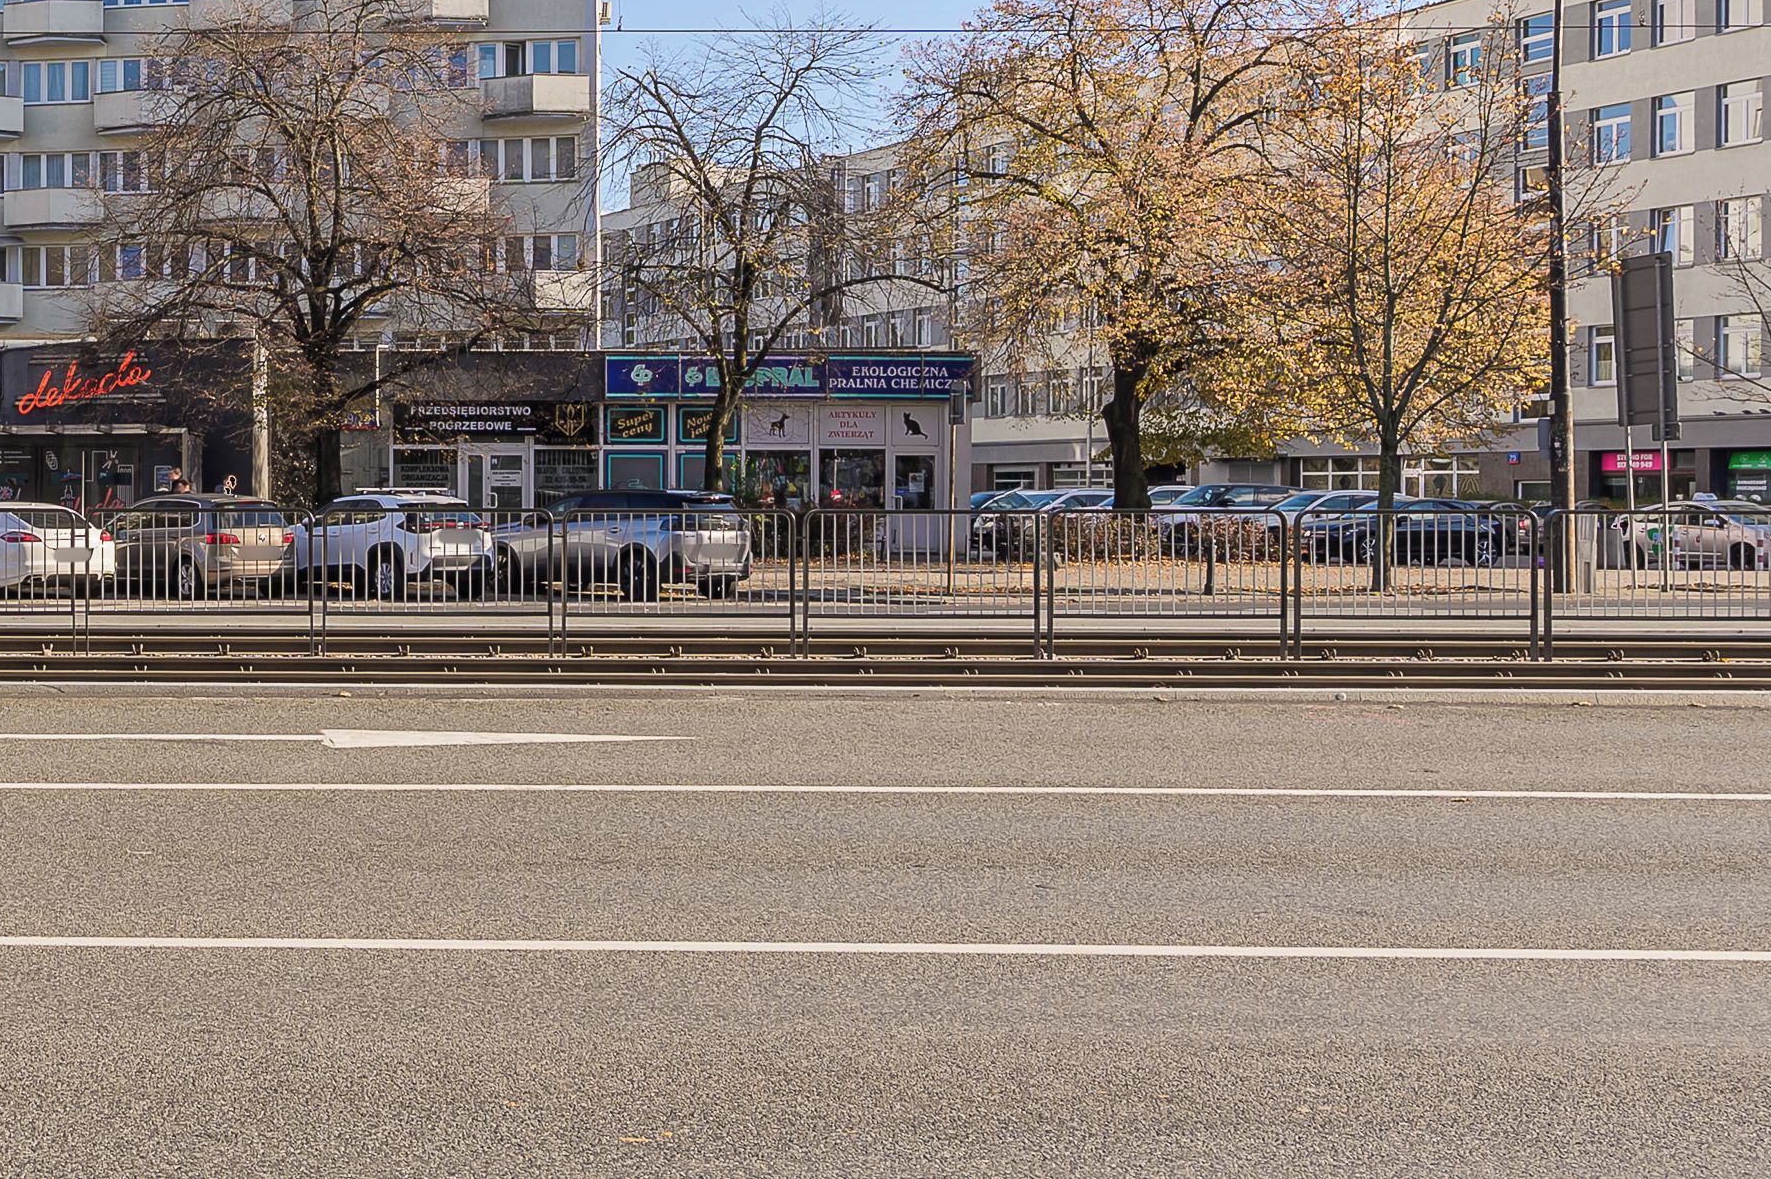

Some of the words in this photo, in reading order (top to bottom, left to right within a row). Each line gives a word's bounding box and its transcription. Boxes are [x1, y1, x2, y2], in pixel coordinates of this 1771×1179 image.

[851, 366, 949, 377] EKOLOGICZNA
[828, 378, 887, 389] PRALNIA
[890, 378, 972, 390] CHEMICZA
[410, 404, 531, 418] PRZEDSIĘBIORSTWO
[827, 410, 877, 419] ARTYKUŁY
[617, 410, 655, 429] Super
[839, 420, 858, 428] DLA
[430, 421, 512, 431] POGRZEBOWE
[622, 423, 653, 438] ceny
[827, 430, 875, 440] ZWIERZĄT
